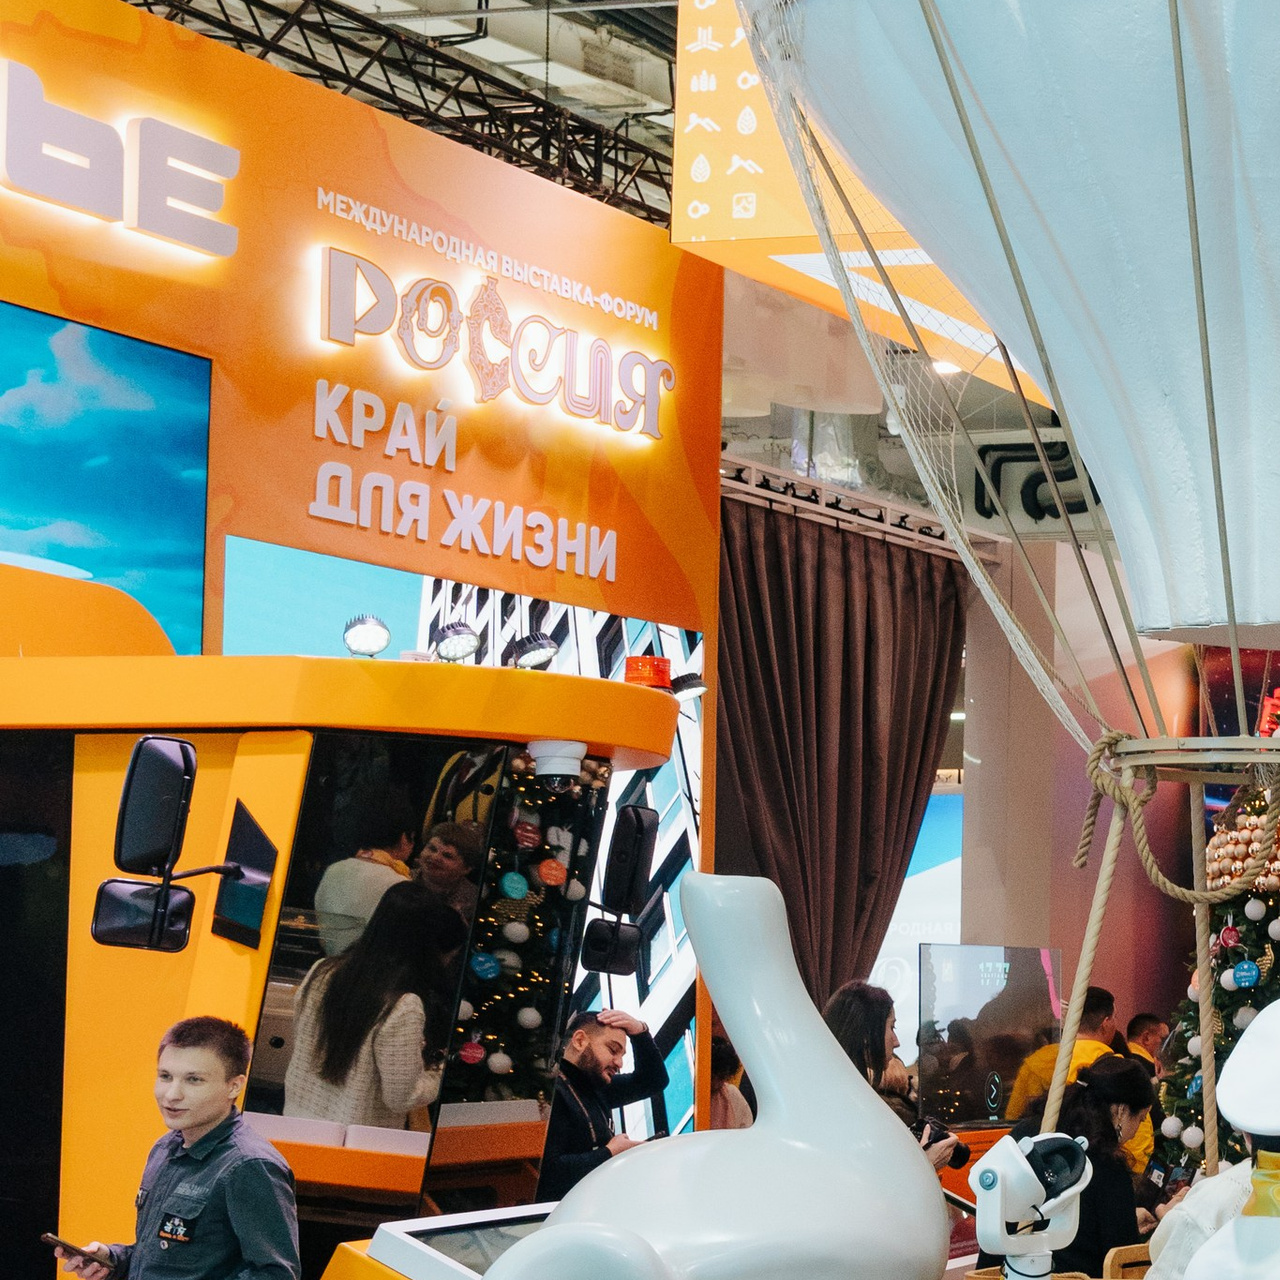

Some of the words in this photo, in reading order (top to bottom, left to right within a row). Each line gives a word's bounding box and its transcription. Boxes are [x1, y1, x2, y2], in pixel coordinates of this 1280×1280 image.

[316, 186, 499, 274] МЕЖДУНАРОДНАЯ
[501, 255, 659, 331] ВЫСТАВКА-ФОРУМ
[320, 246, 676, 441] РОССИЯ
[314, 379, 458, 472] КРАЙ
[308, 461, 431, 542] ДЛЯ
[440, 489, 618, 584] ЖИЗНИ
